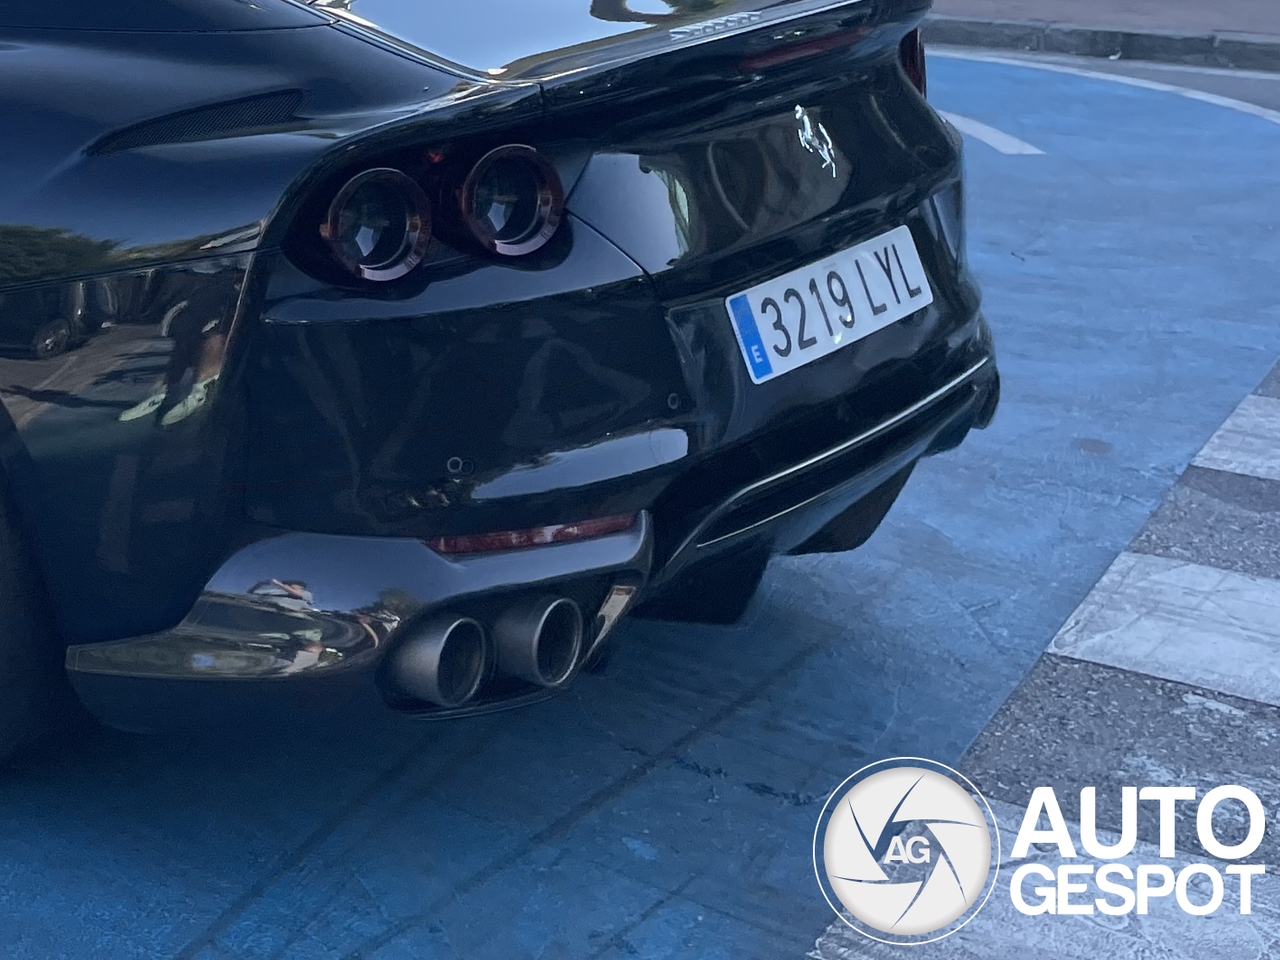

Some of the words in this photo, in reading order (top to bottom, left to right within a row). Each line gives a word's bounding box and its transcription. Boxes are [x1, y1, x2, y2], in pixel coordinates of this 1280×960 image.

[761, 271, 856, 358] 3219
[854, 244, 922, 317] LYL
[751, 344, 763, 364] E
